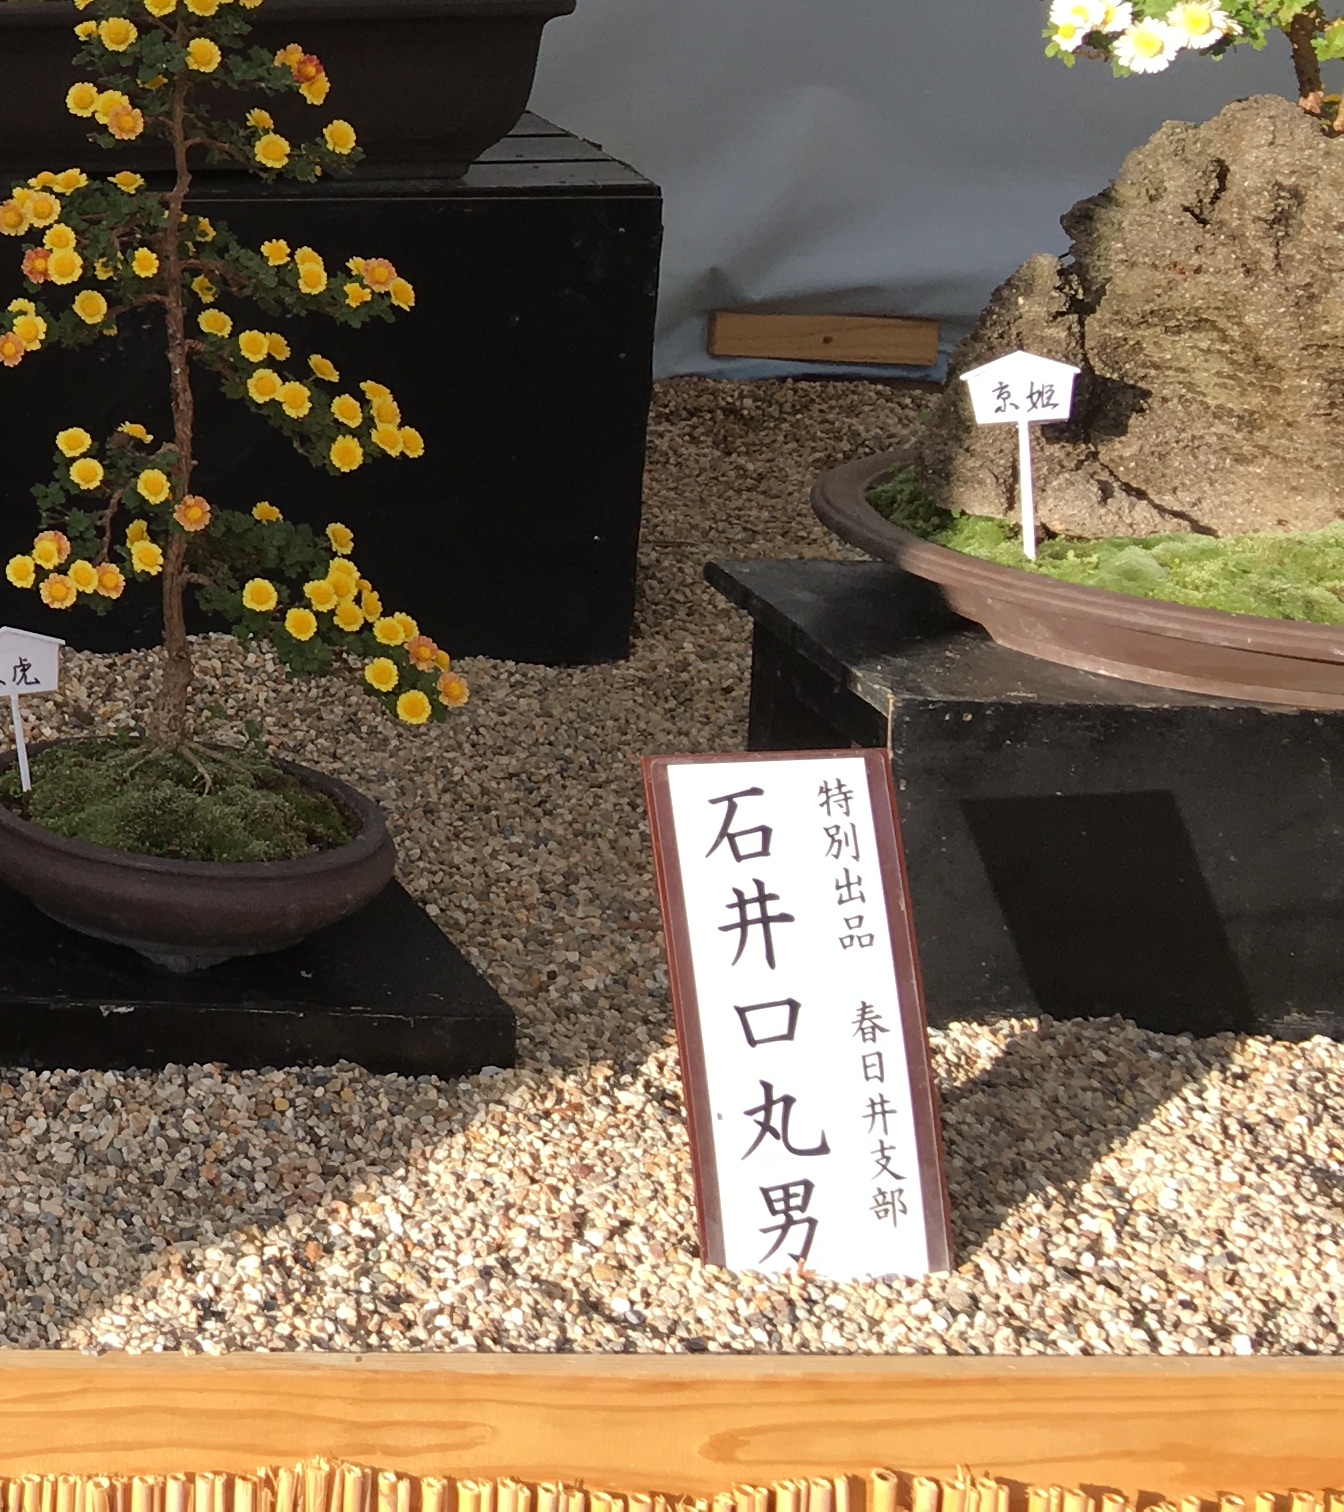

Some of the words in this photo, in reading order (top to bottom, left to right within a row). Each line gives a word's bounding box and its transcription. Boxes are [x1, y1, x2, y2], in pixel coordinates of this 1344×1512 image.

[991, 381, 1060, 414] 京姫
[704, 786, 831, 1265] 石井口丸男
[817, 777, 875, 951] 特別出品
[850, 999, 908, 1229] 春日井支部
